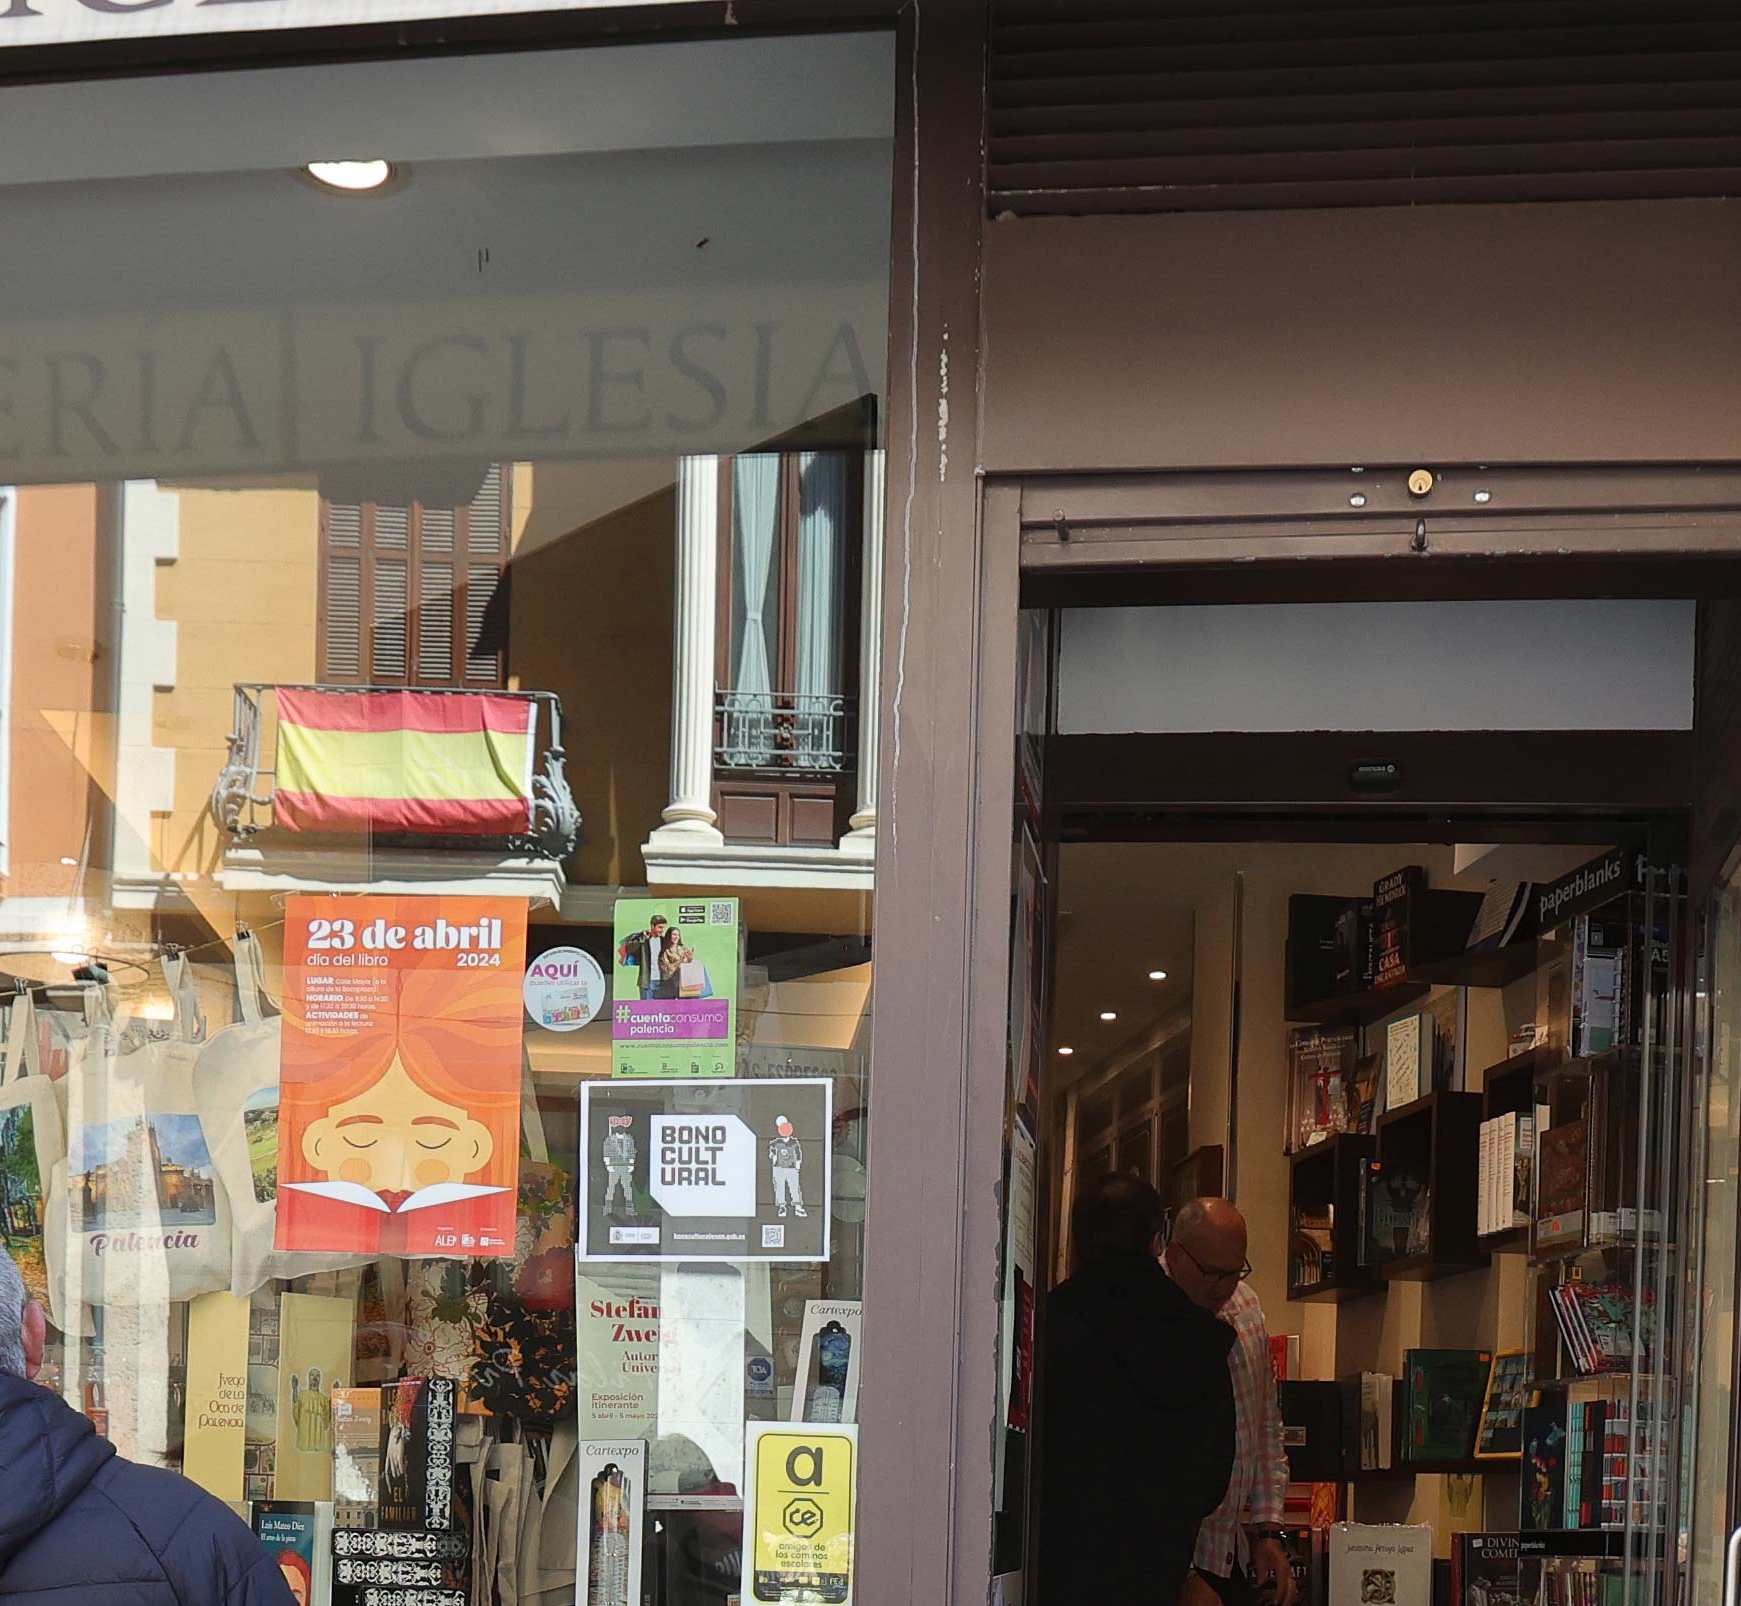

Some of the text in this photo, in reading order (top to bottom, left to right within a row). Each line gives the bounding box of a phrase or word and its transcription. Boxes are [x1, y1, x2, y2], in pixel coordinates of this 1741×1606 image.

[354, 318, 877, 445] IGLESIA
[1540, 859, 1621, 922] paperblanks
[308, 917, 503, 950] 23 de abril
[307, 953, 388, 966] día del libro
[456, 953, 501, 967] 2024
[1379, 952, 1400, 972] CASA
[530, 960, 580, 980] AQUÍ
[630, 1024, 675, 1036] palencia
[661, 1125, 726, 1144] BONO
[661, 1146, 724, 1165] CULT
[661, 1167, 726, 1186] URAL
[90, 1230, 199, 1256] Palencia
[590, 1297, 664, 1319] Stefan
[810, 1304, 862, 1318] Cartexpo
[622, 1351, 658, 1362] Autor
[591, 1393, 643, 1404] Exposición
[591, 1401, 639, 1409] itinerante
[598, 1411, 614, 1419] abril
[626, 1413, 644, 1421] mayo
[586, 1444, 639, 1457] Cartexpo
[785, 1445, 823, 1487] a
[274, 1521, 291, 1530] Mateo
[779, 1542, 826, 1552] amigos de
[775, 1550, 788, 1559] los
